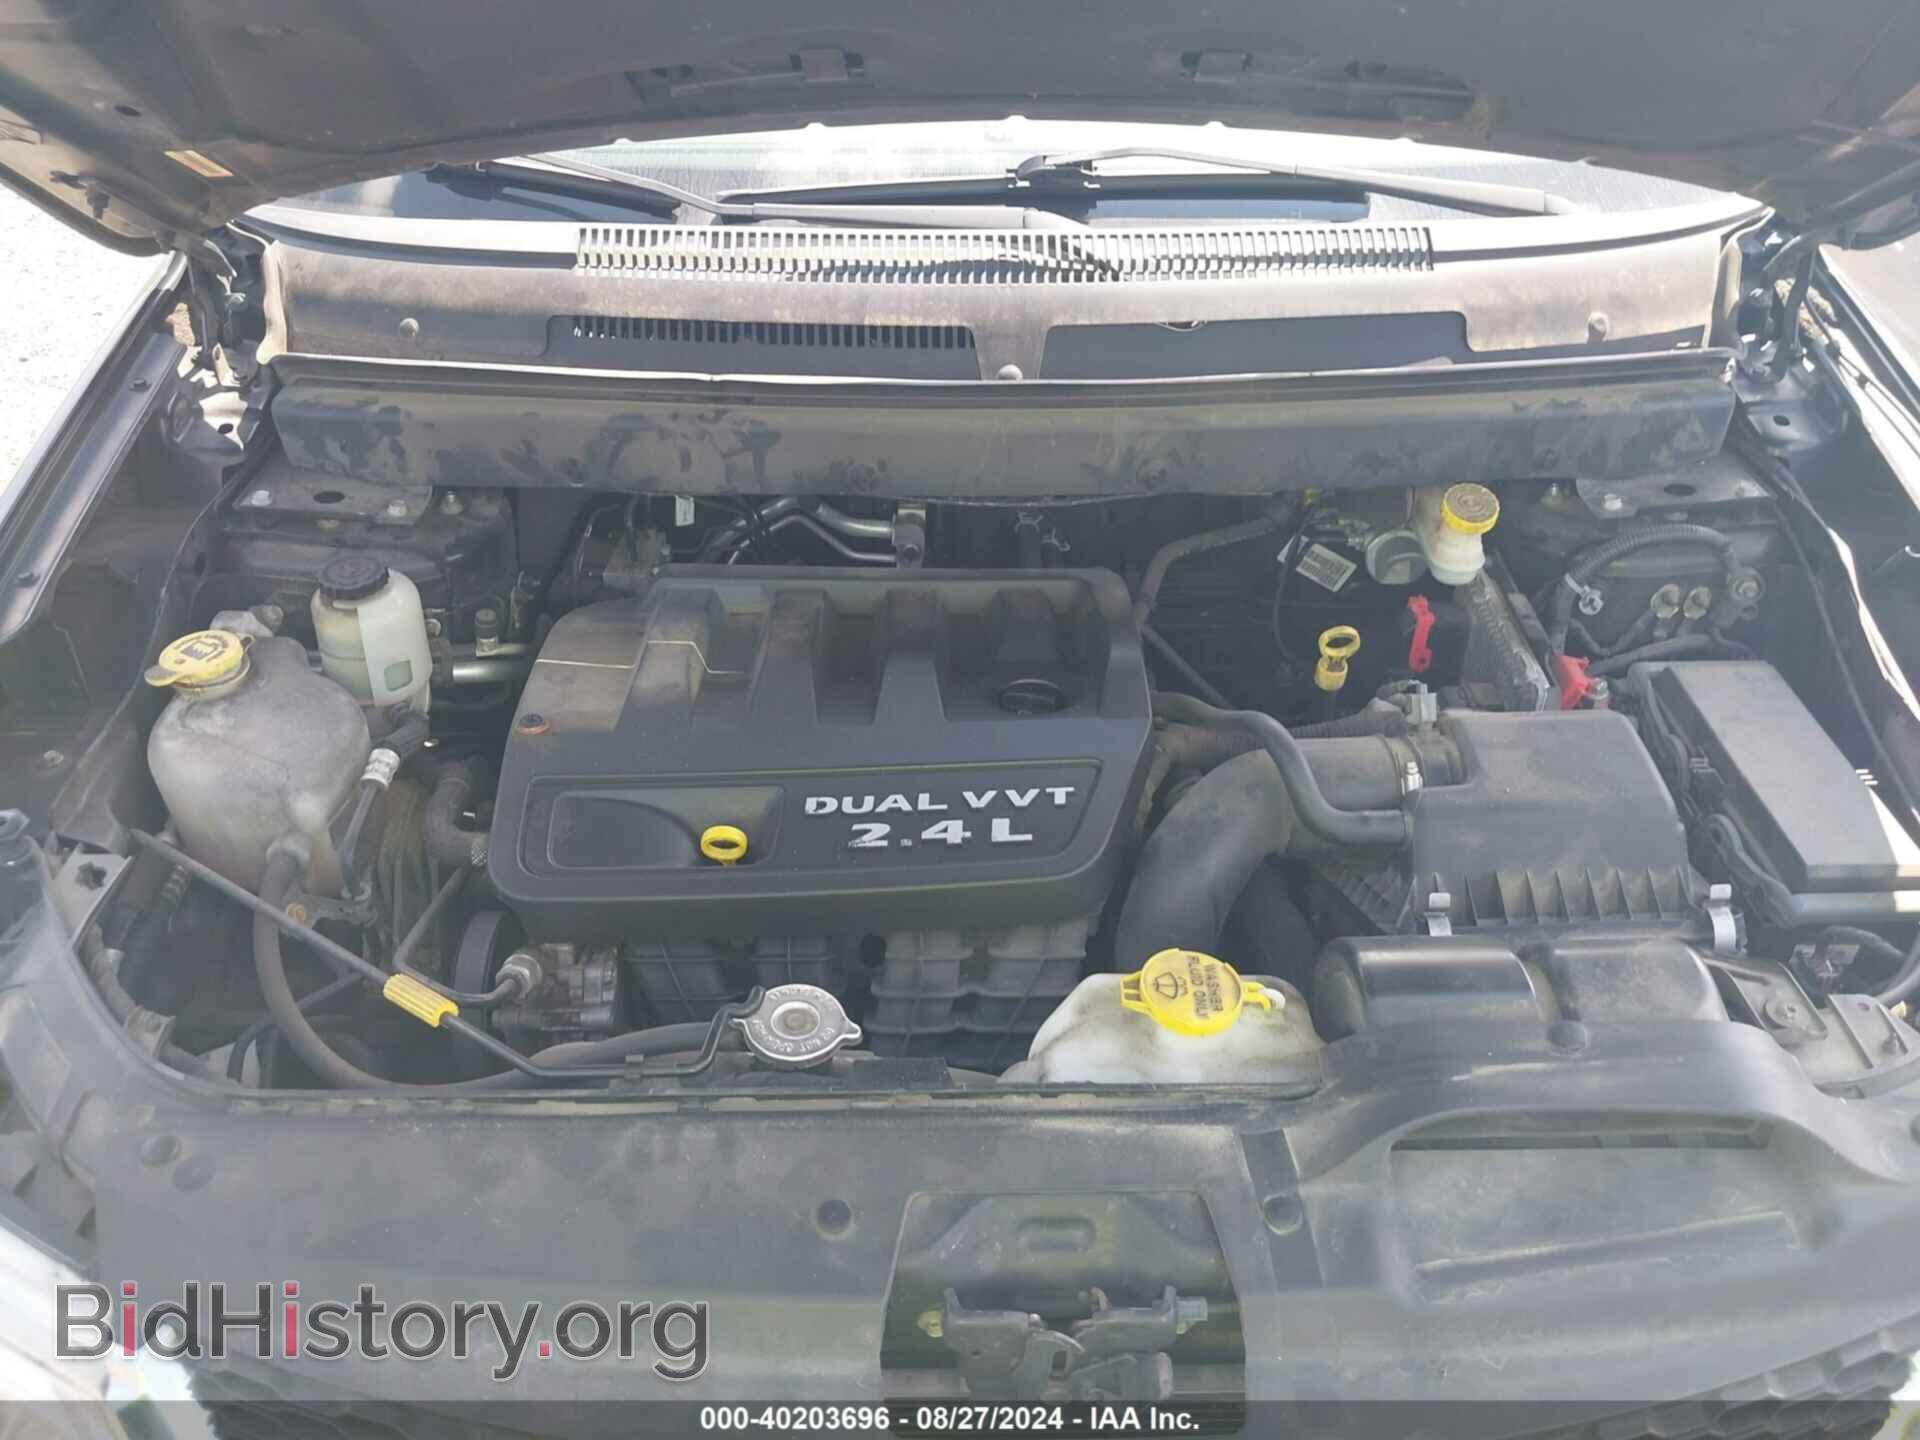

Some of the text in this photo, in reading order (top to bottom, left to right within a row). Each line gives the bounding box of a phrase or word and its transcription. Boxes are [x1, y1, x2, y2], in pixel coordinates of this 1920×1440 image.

[804, 786, 1075, 815] DUAL VVT
[1187, 955, 1209, 1019] FLUID ONLY
[1204, 964, 1224, 1012] WASHER
